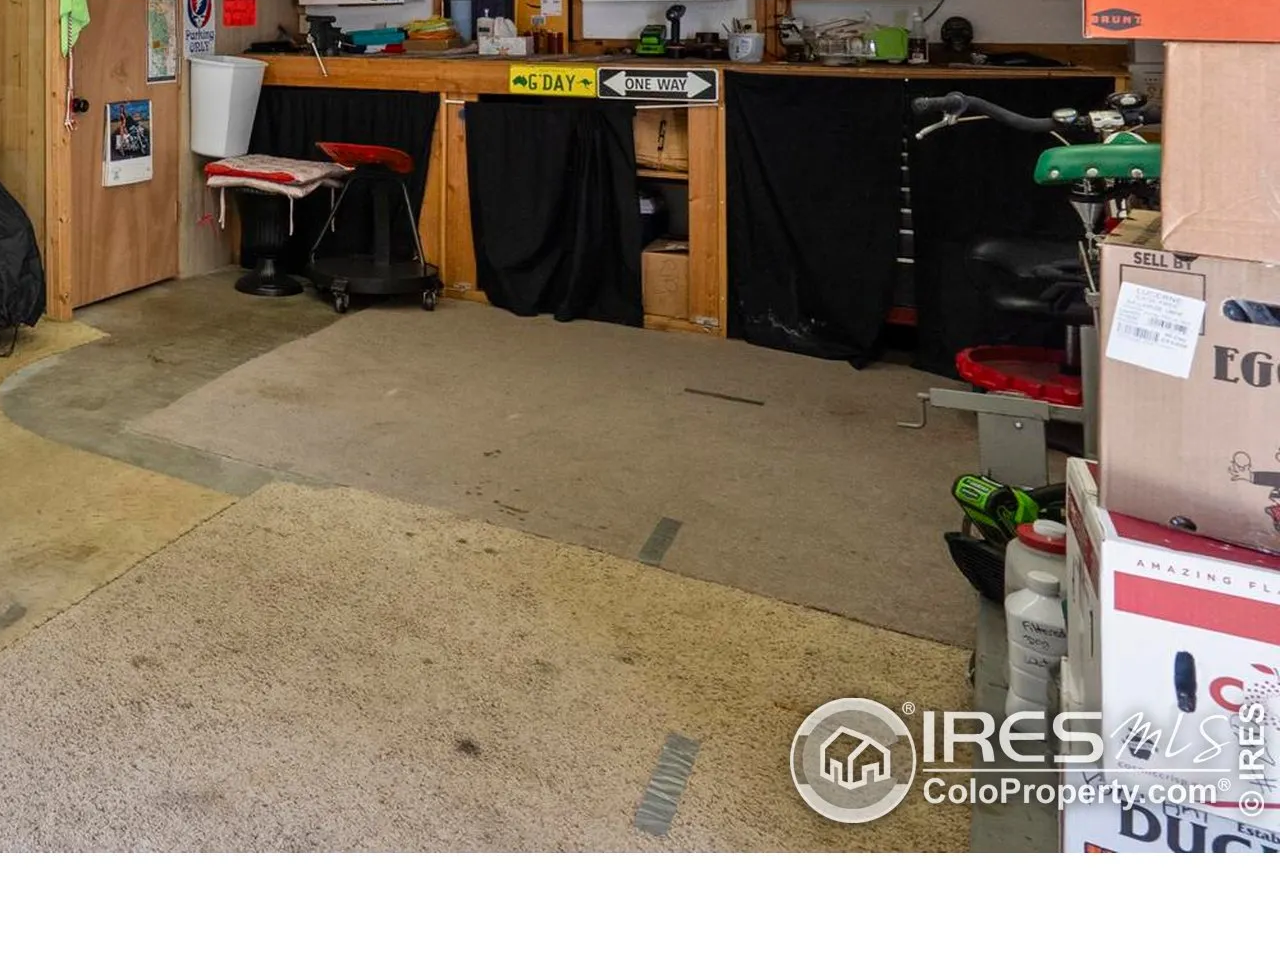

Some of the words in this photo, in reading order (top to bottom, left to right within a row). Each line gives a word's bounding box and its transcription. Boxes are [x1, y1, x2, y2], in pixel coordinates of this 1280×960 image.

[185, 30, 214, 41] Parking
[528, 74, 575, 91] G'DAY
[625, 77, 652, 90] ONE
[658, 78, 687, 91] WAY
[1133, 251, 1168, 268] SELL
[1213, 344, 1280, 388] EG
[1136, 559, 1232, 585] AMAZING
[1249, 581, 1280, 595] FL
